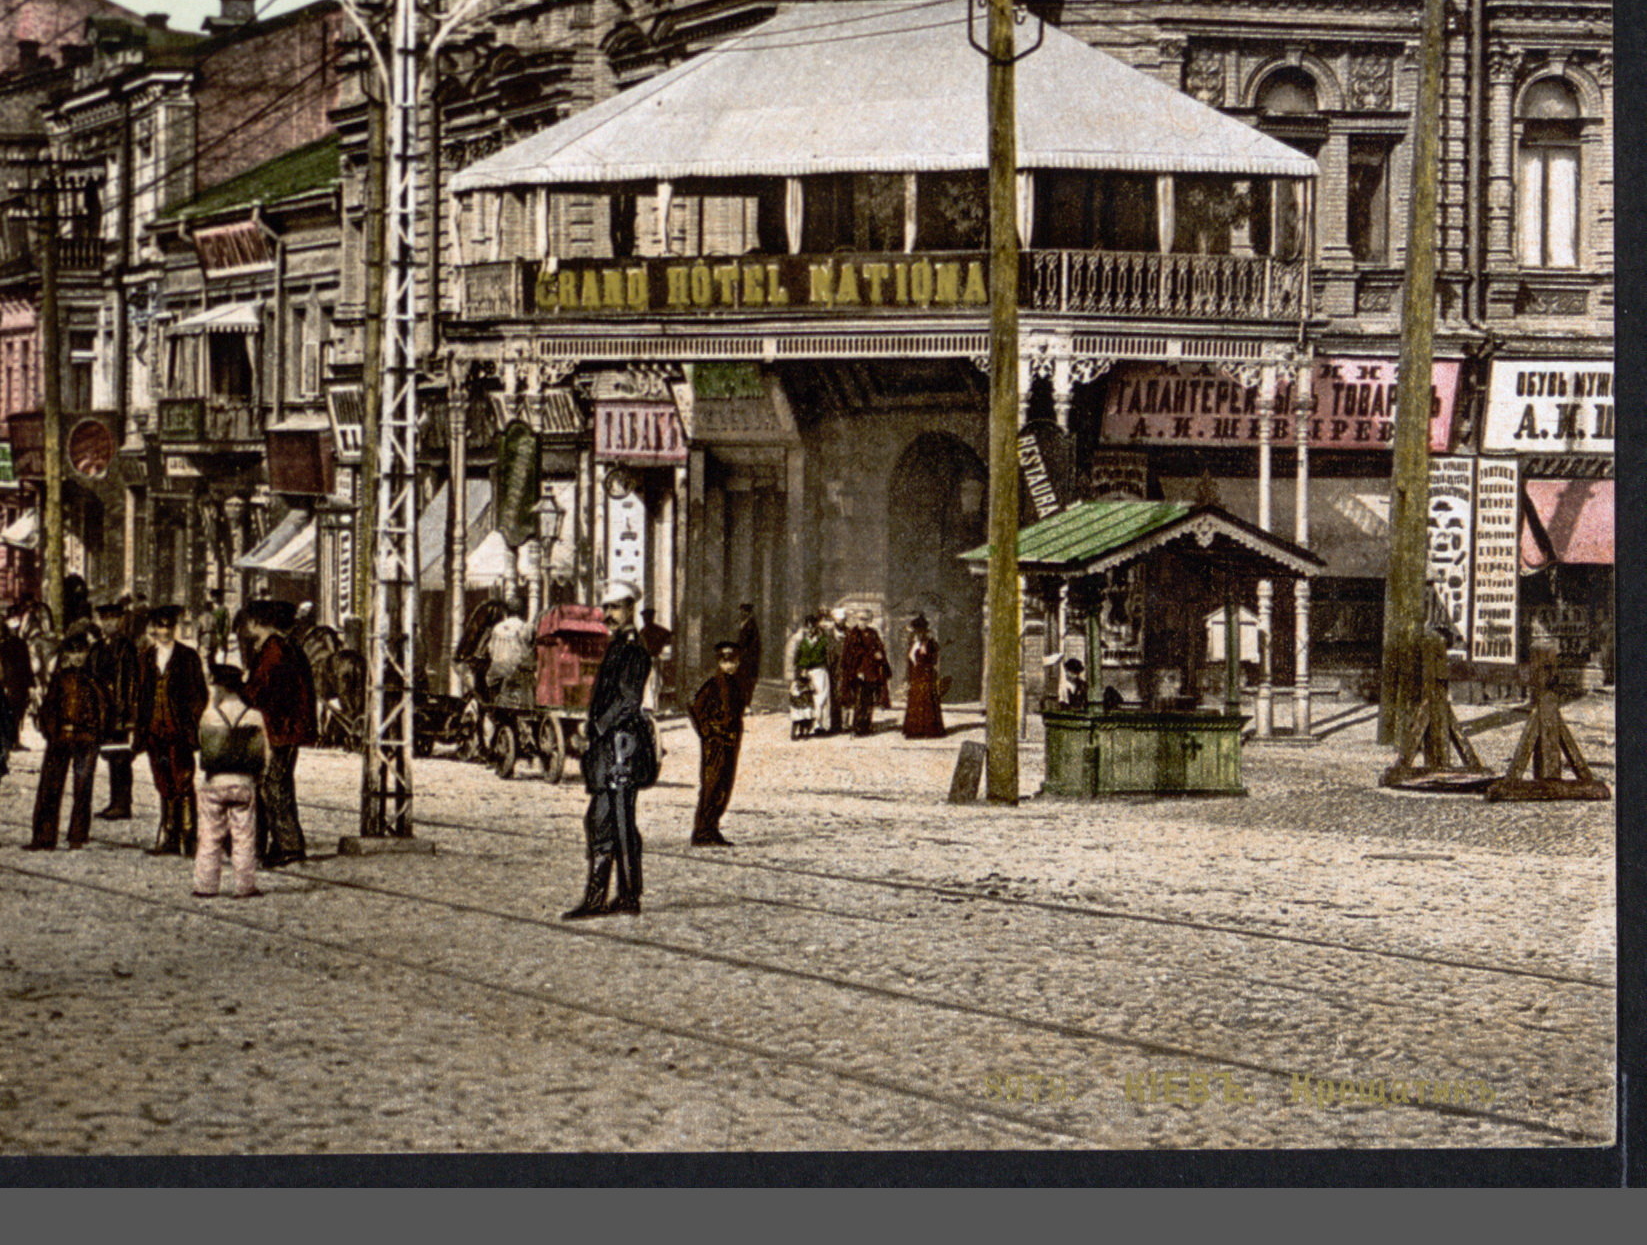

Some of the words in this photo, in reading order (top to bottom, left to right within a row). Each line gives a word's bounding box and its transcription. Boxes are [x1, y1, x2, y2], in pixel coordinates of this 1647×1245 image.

[535, 268, 649, 307] GRAND
[1516, 371, 1568, 397] ОБУВЬ
[1573, 371, 1614, 397] МУЖ
